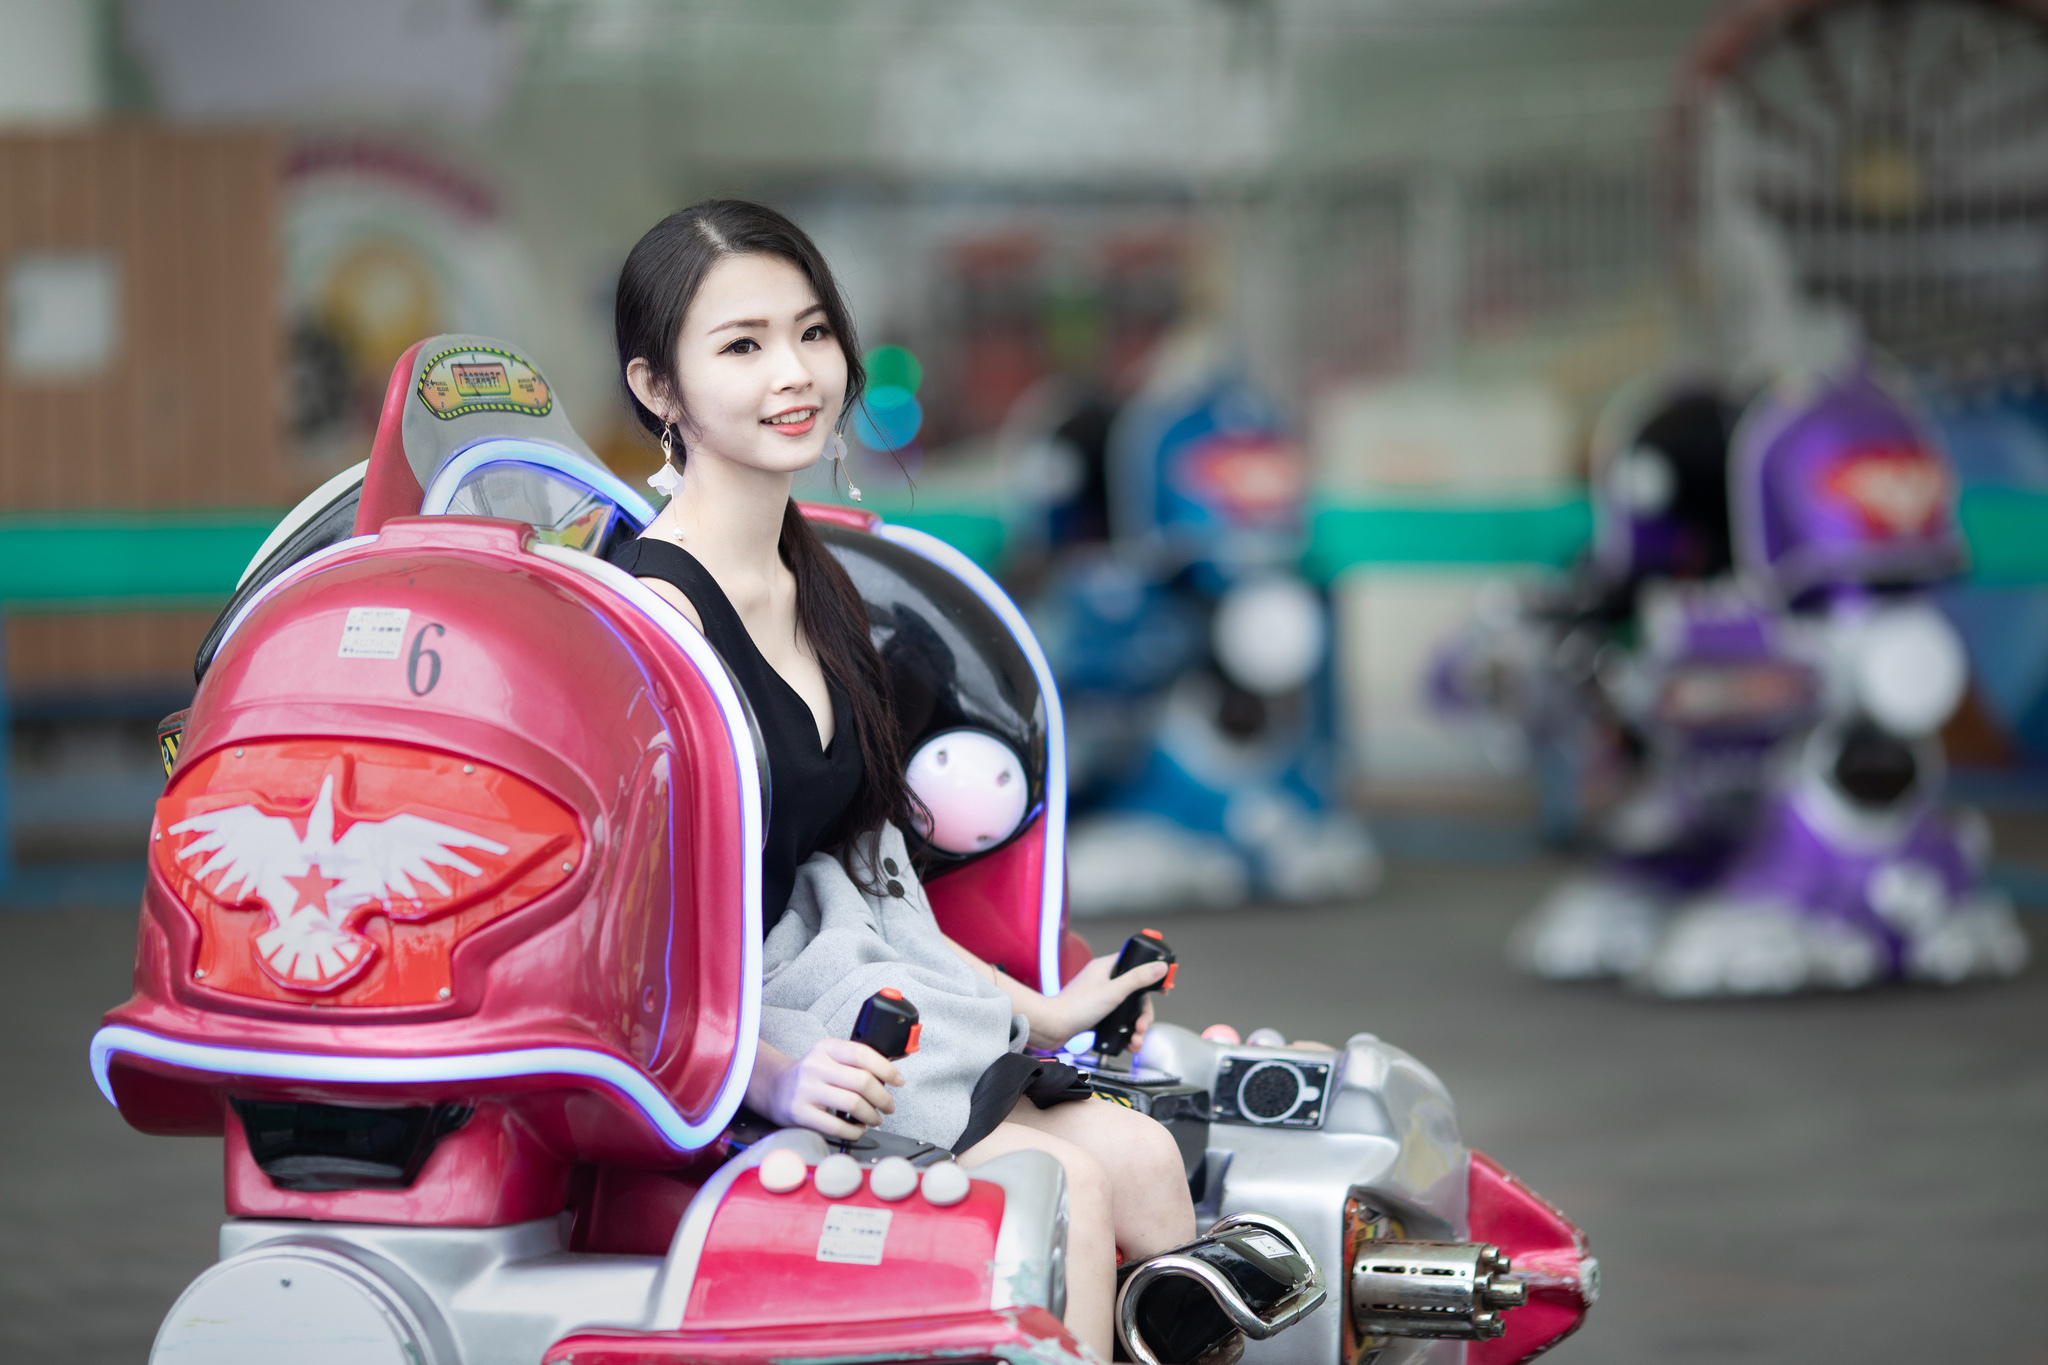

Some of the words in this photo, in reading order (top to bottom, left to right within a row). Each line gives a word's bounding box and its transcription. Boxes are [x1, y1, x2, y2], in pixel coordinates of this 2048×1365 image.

[349, 616, 404, 624] CAUTION
[342, 639, 398, 648] CAUTION
[407, 623, 445, 697] 6
